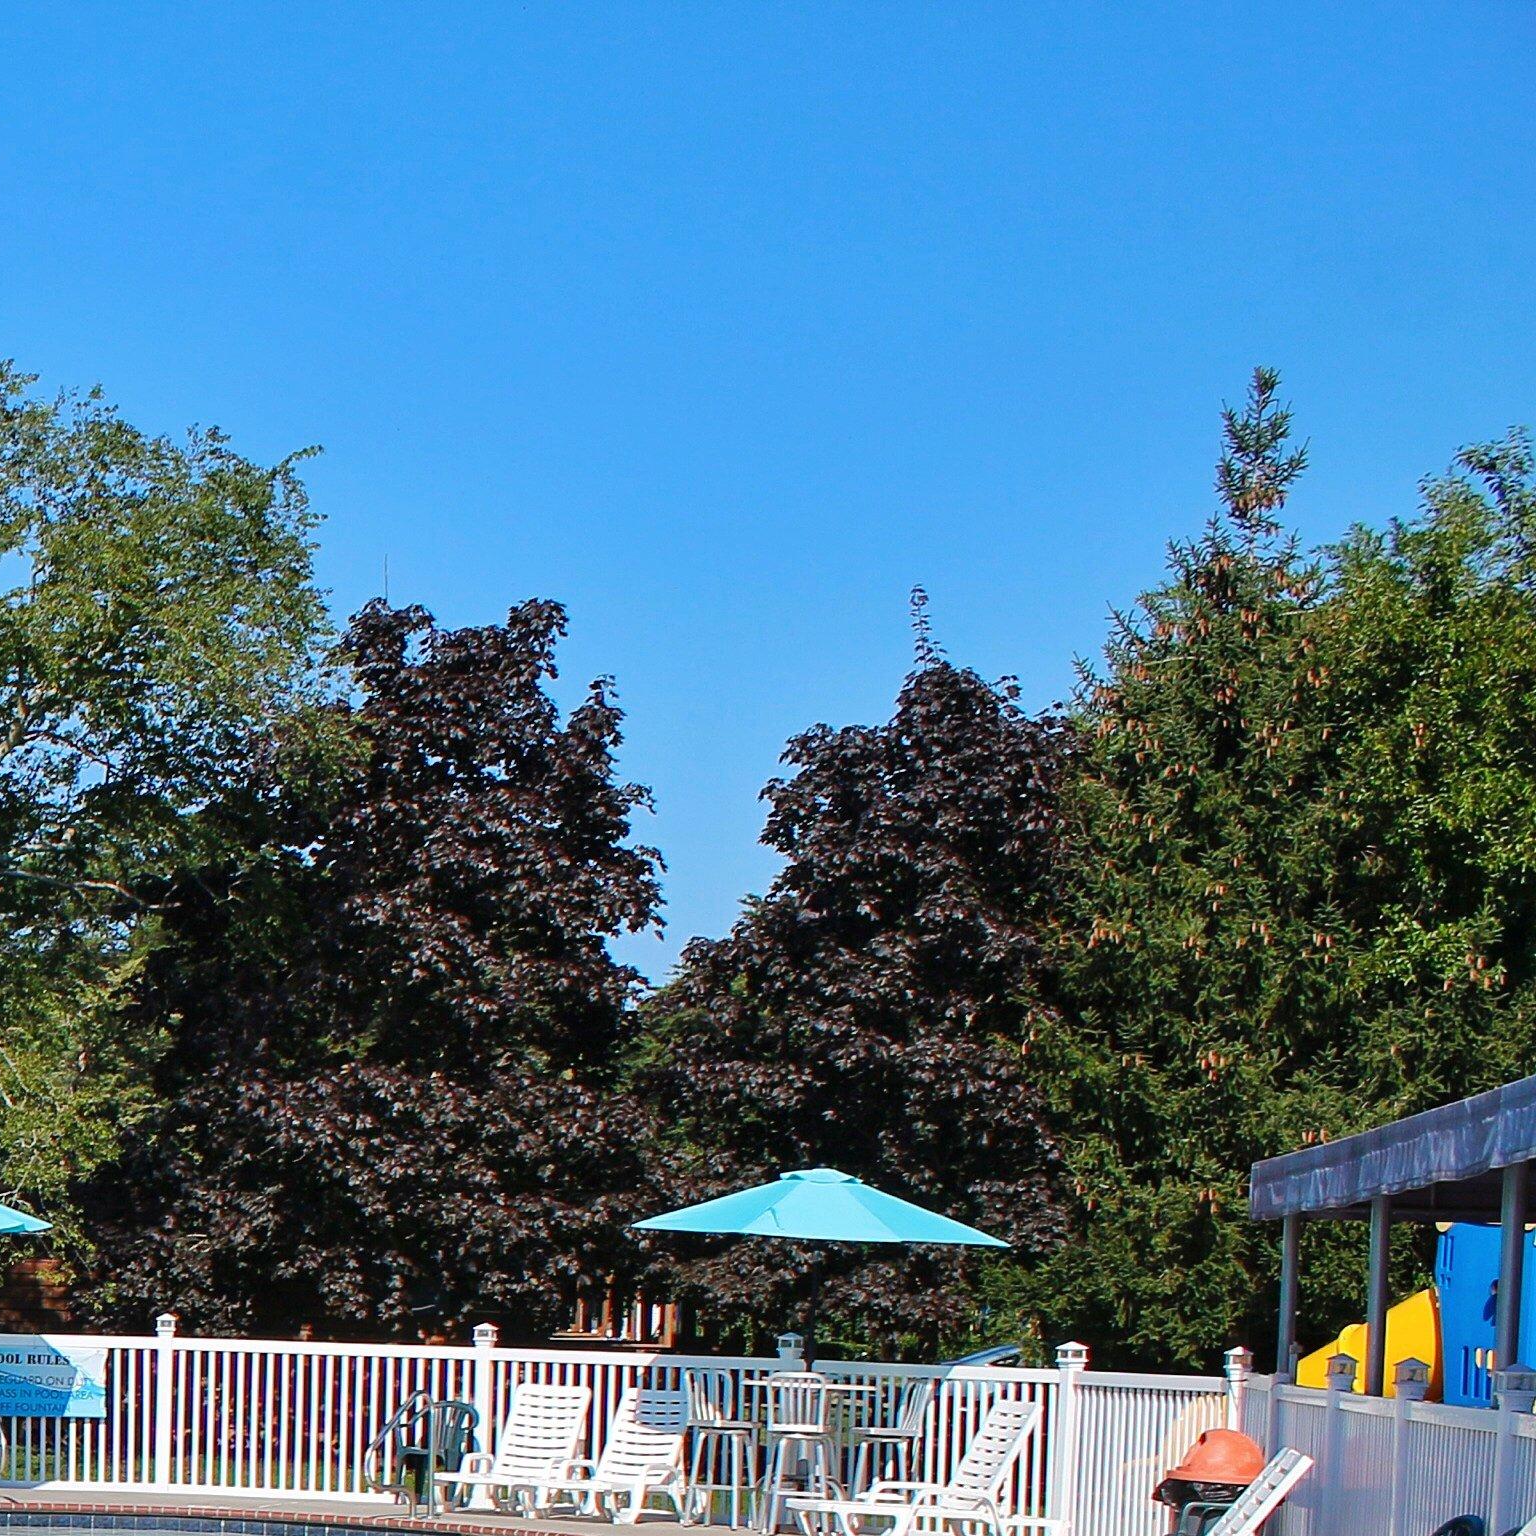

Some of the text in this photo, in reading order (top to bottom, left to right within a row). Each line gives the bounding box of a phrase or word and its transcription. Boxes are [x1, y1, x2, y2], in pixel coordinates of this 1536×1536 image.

[27, 1354, 71, 1365] RULES
[45, 1375, 65, 1386] ON
[20, 1388, 32, 1398] IN
[34, 1388, 66, 1399] POOL
